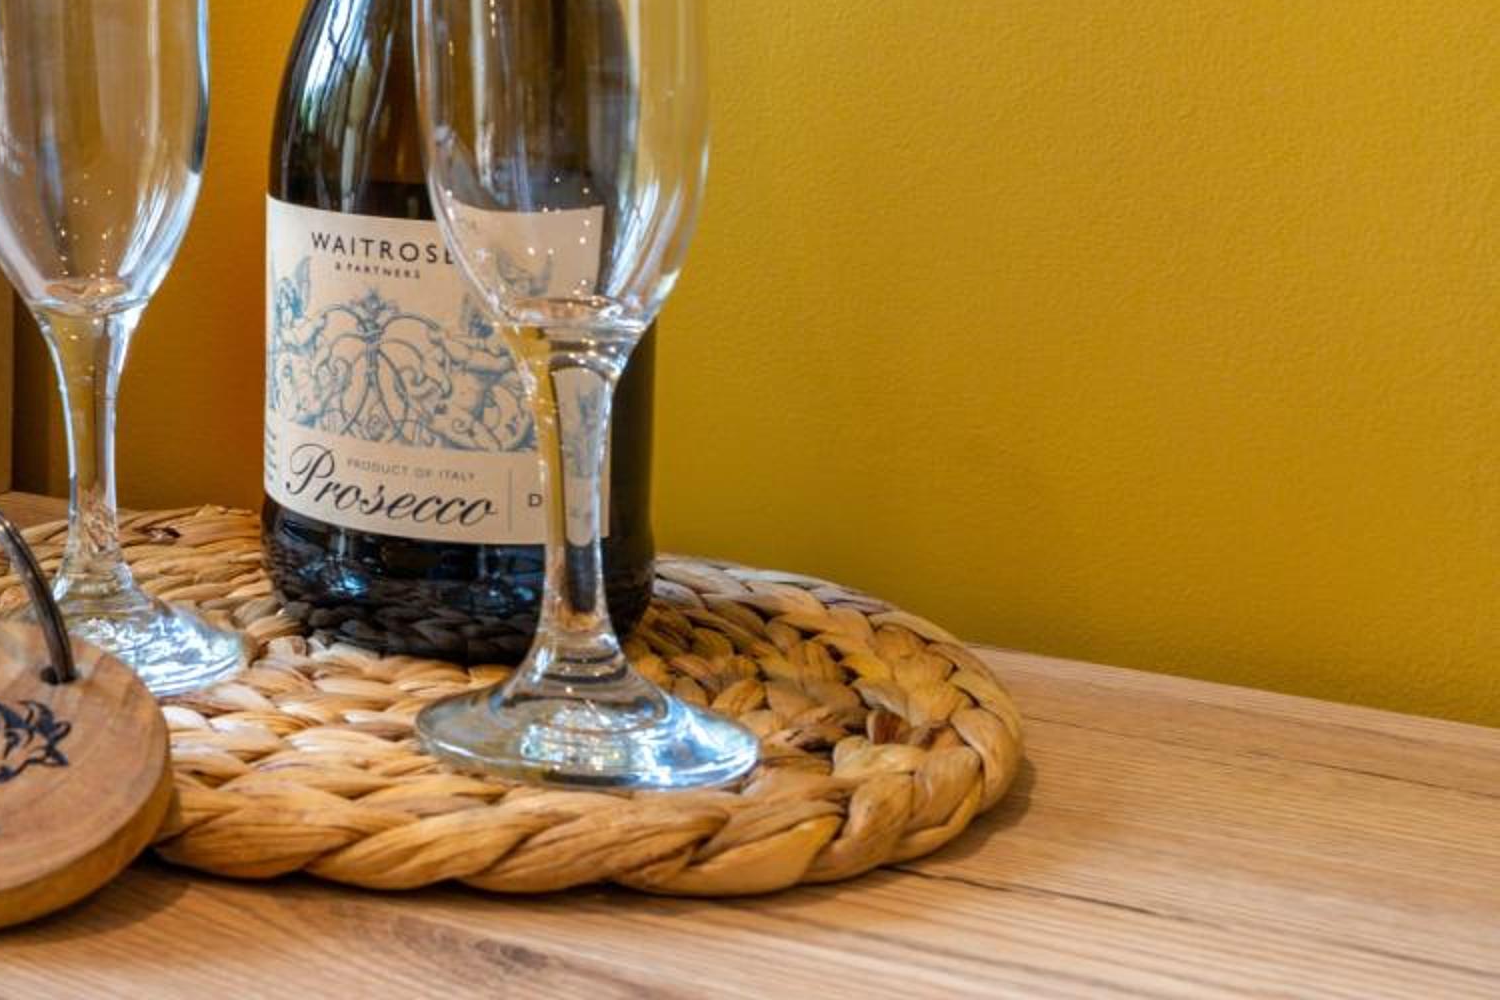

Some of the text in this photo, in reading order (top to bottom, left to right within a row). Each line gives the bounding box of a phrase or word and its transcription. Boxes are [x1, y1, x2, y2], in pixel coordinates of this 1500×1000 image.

[347, 263, 421, 279] PARTNERS
[347, 458, 475, 482] PRODUCT OF ITALY
[285, 442, 498, 528] Prosecco
